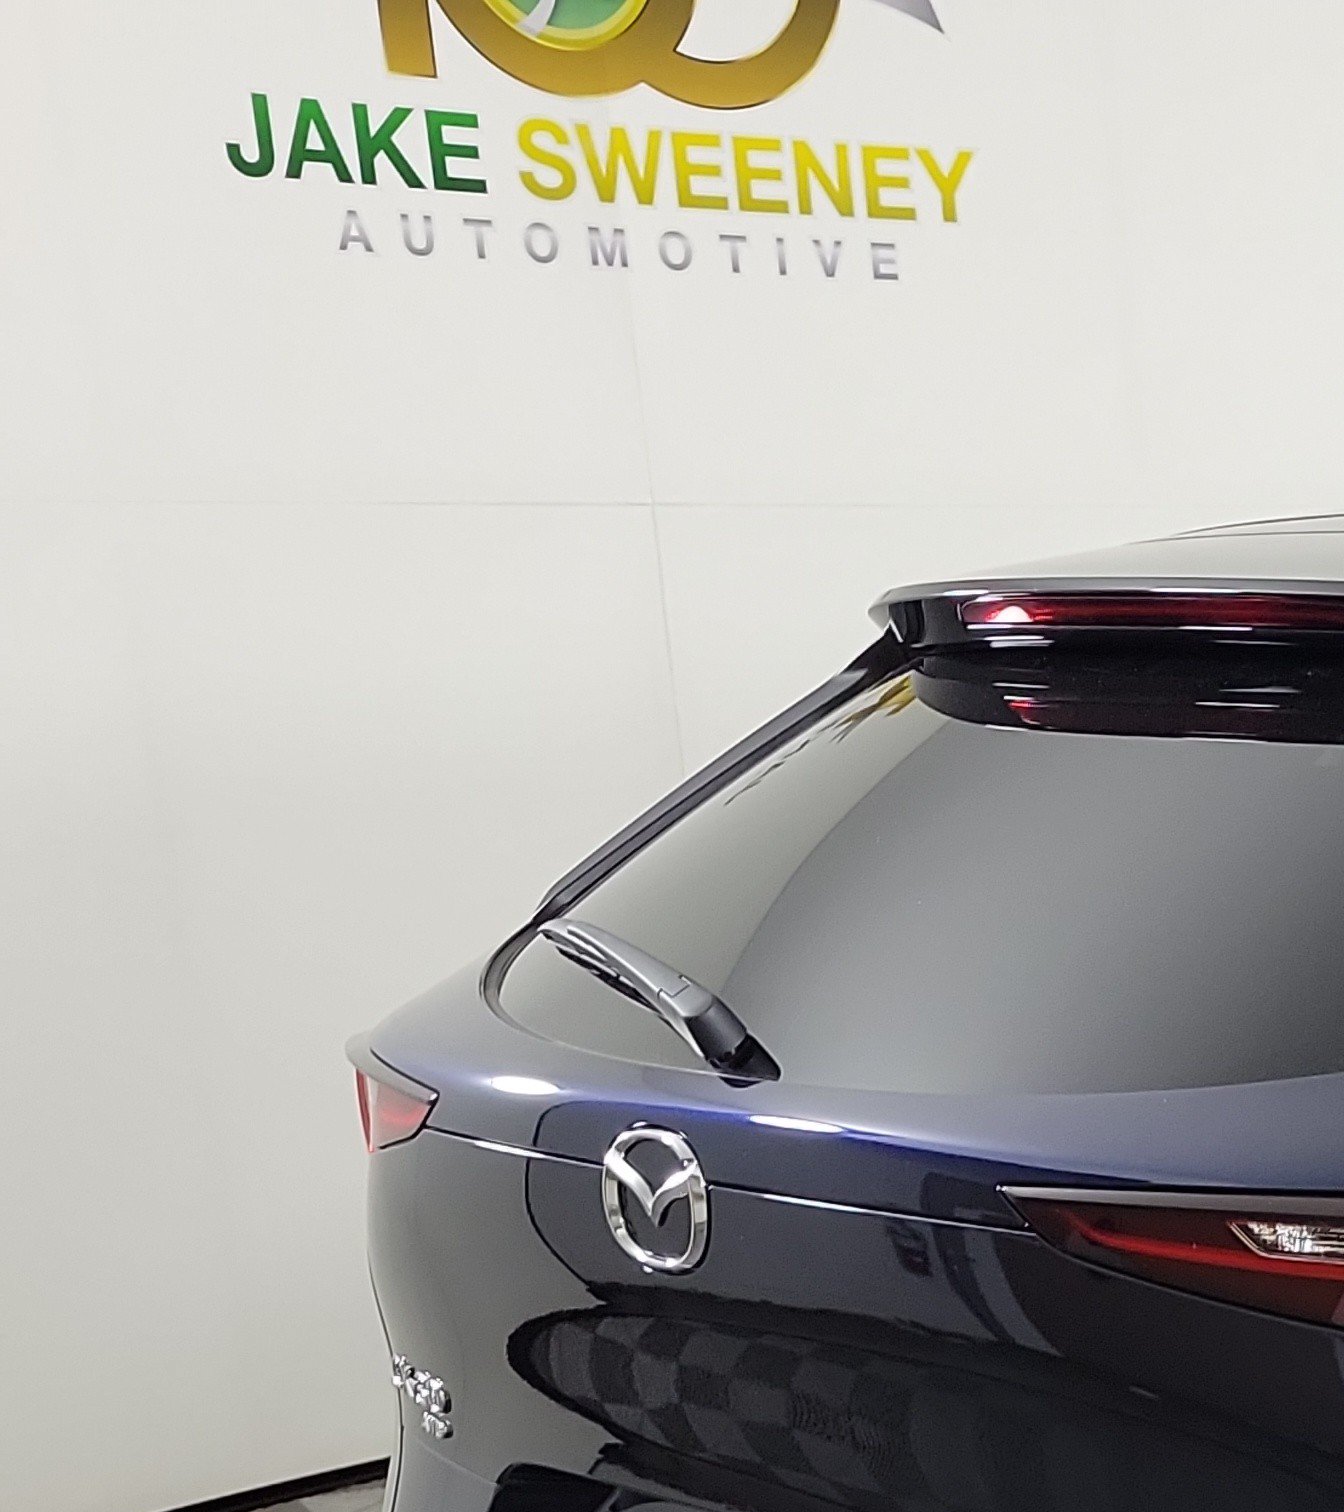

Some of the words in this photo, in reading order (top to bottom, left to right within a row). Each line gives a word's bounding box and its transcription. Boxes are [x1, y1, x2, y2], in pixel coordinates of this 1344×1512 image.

[225, 93, 488, 194] JAKE
[517, 118, 974, 223] SWEENEY
[338, 210, 900, 282] AUTOMOTIVE
